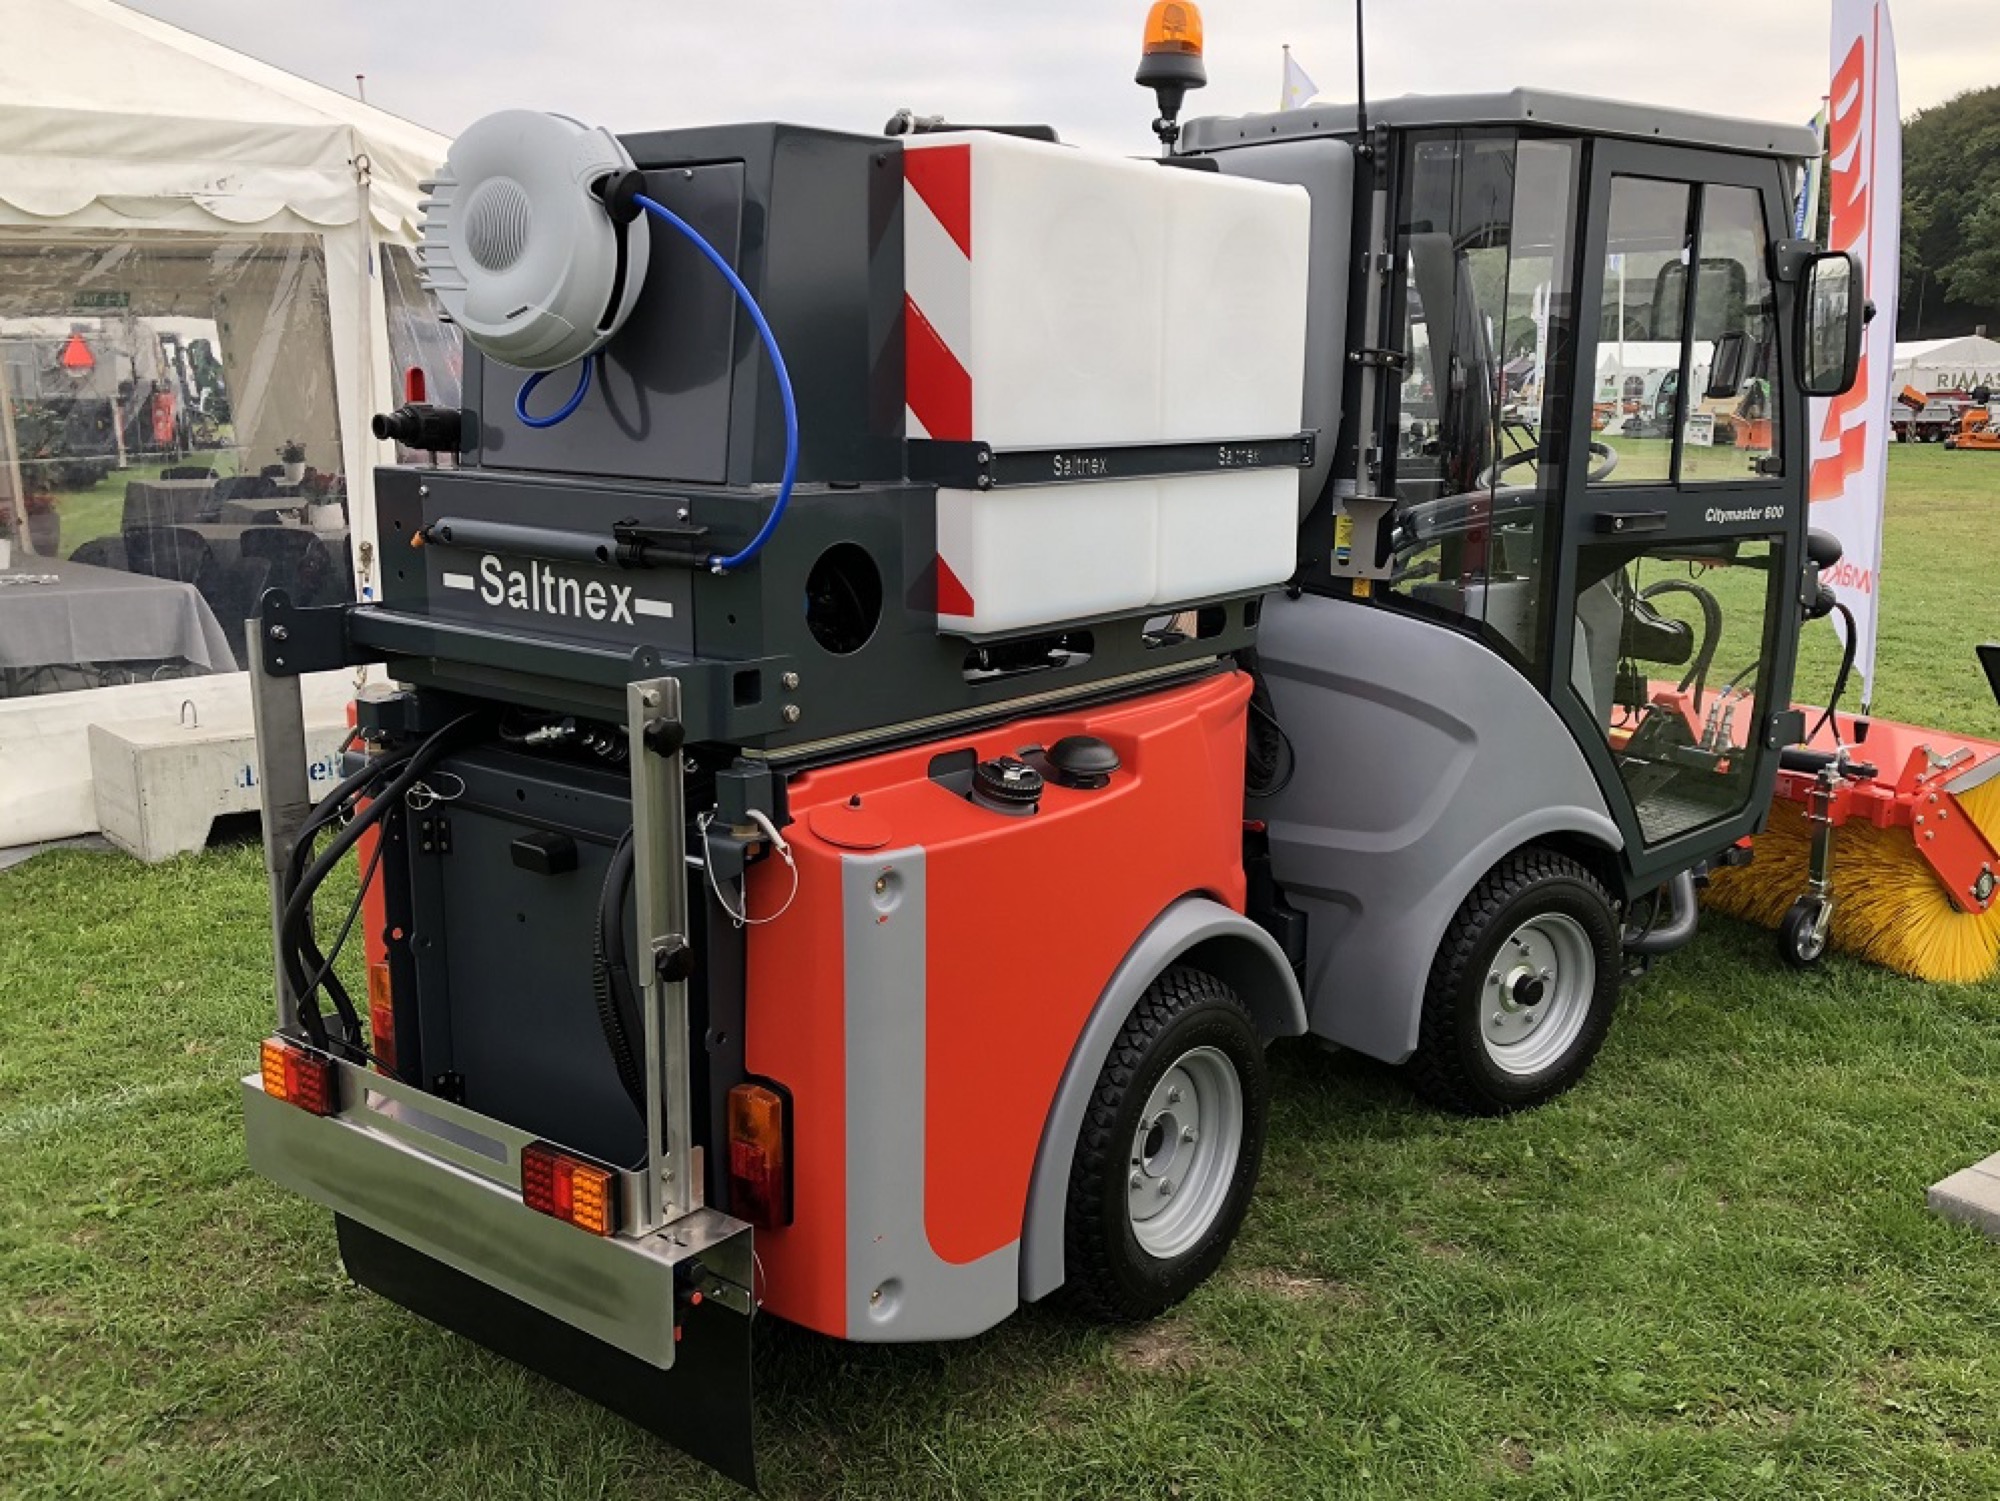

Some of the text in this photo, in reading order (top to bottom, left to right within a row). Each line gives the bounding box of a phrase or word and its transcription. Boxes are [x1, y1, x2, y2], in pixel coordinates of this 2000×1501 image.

[1705, 505, 1785, 523] Citymaster 600
[480, 554, 635, 625] Saltnex
